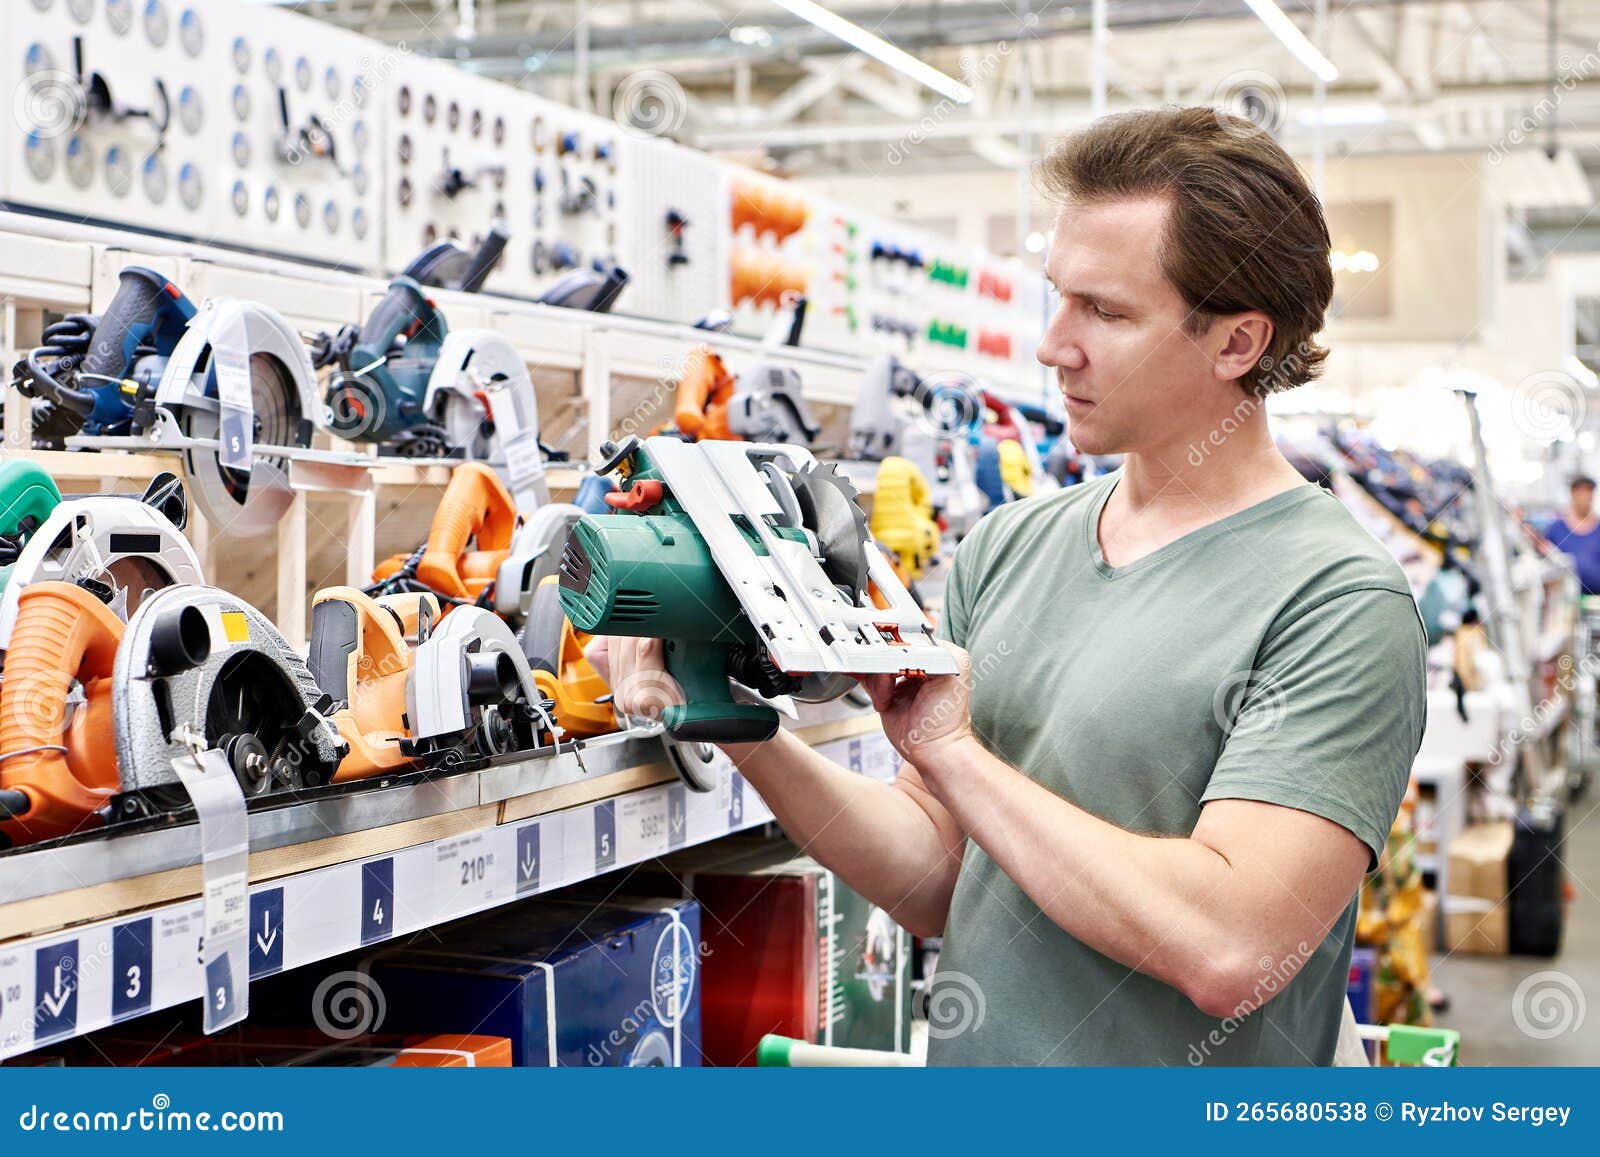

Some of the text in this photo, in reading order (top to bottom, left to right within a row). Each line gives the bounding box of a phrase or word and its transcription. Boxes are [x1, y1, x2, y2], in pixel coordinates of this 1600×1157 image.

[231, 436, 240, 453] 5
[601, 833, 610, 857] 5
[461, 856, 485, 886] 210
[373, 898, 384, 925] 4
[126, 965, 141, 998] 3
[216, 987, 226, 1010] 3
